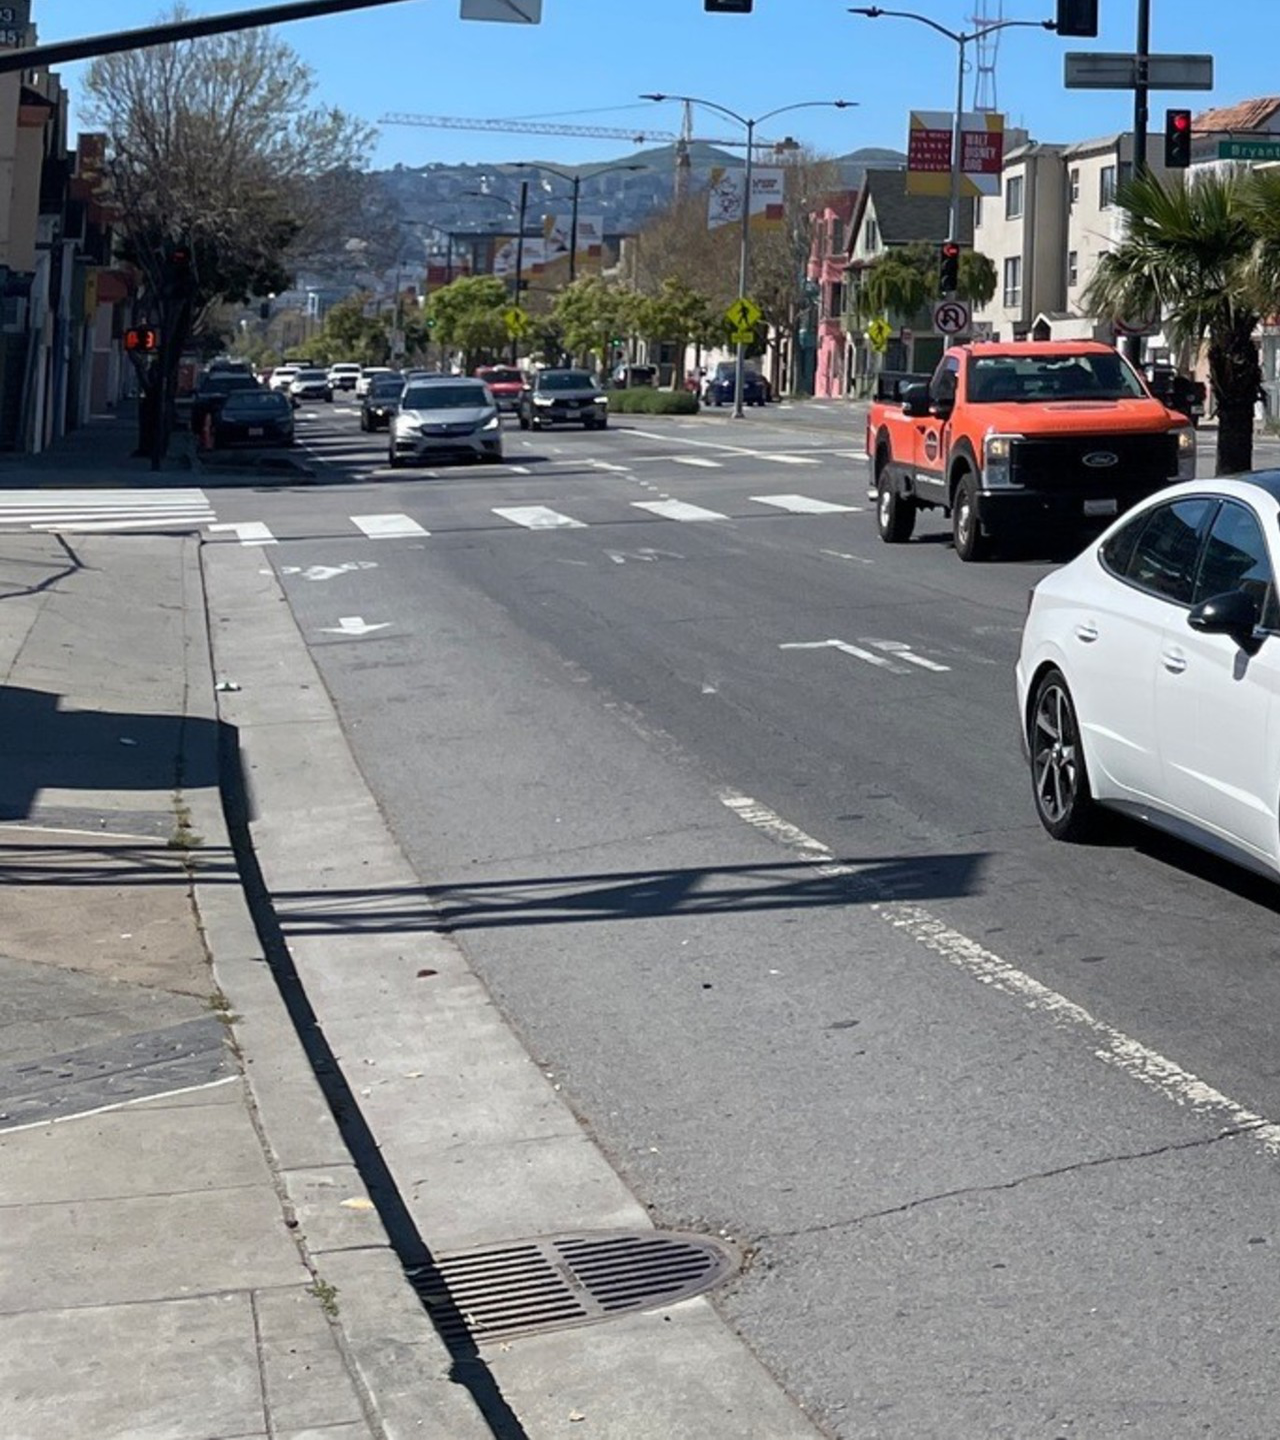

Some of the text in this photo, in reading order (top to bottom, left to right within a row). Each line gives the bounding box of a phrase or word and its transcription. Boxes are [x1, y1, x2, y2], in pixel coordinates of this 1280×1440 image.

[964, 133, 989, 145] WALT
[963, 147, 997, 159] DISNEY
[1231, 143, 1280, 158] Bryant
